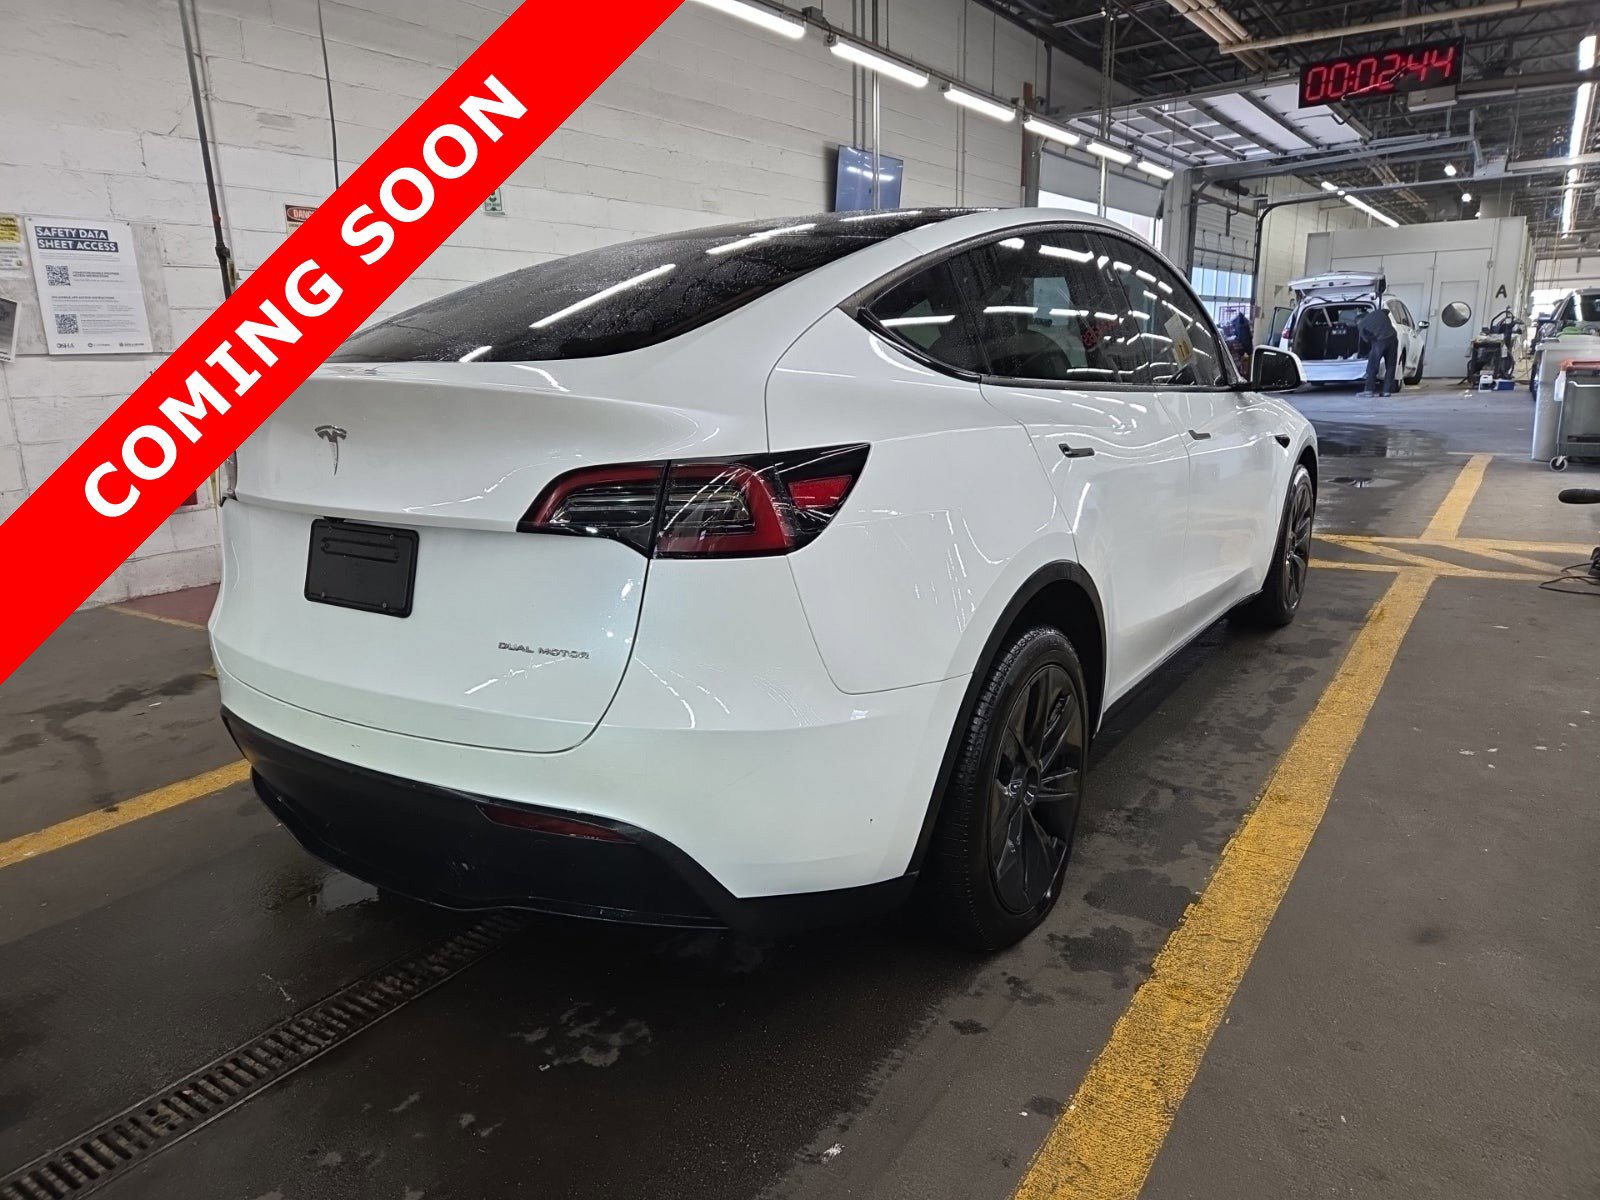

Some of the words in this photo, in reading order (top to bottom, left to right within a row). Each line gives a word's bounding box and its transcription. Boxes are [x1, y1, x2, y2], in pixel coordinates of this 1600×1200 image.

[1304, 46, 1455, 101] 00:02:44
[36, 228, 76, 237] SAFETY
[78, 230, 107, 240] DATA
[38, 239, 74, 249] SHEET
[76, 241, 116, 251] ACCESS
[1495, 284, 1507, 298] A
[498, 642, 534, 653] DUAL
[538, 647, 590, 659] MOTOR
